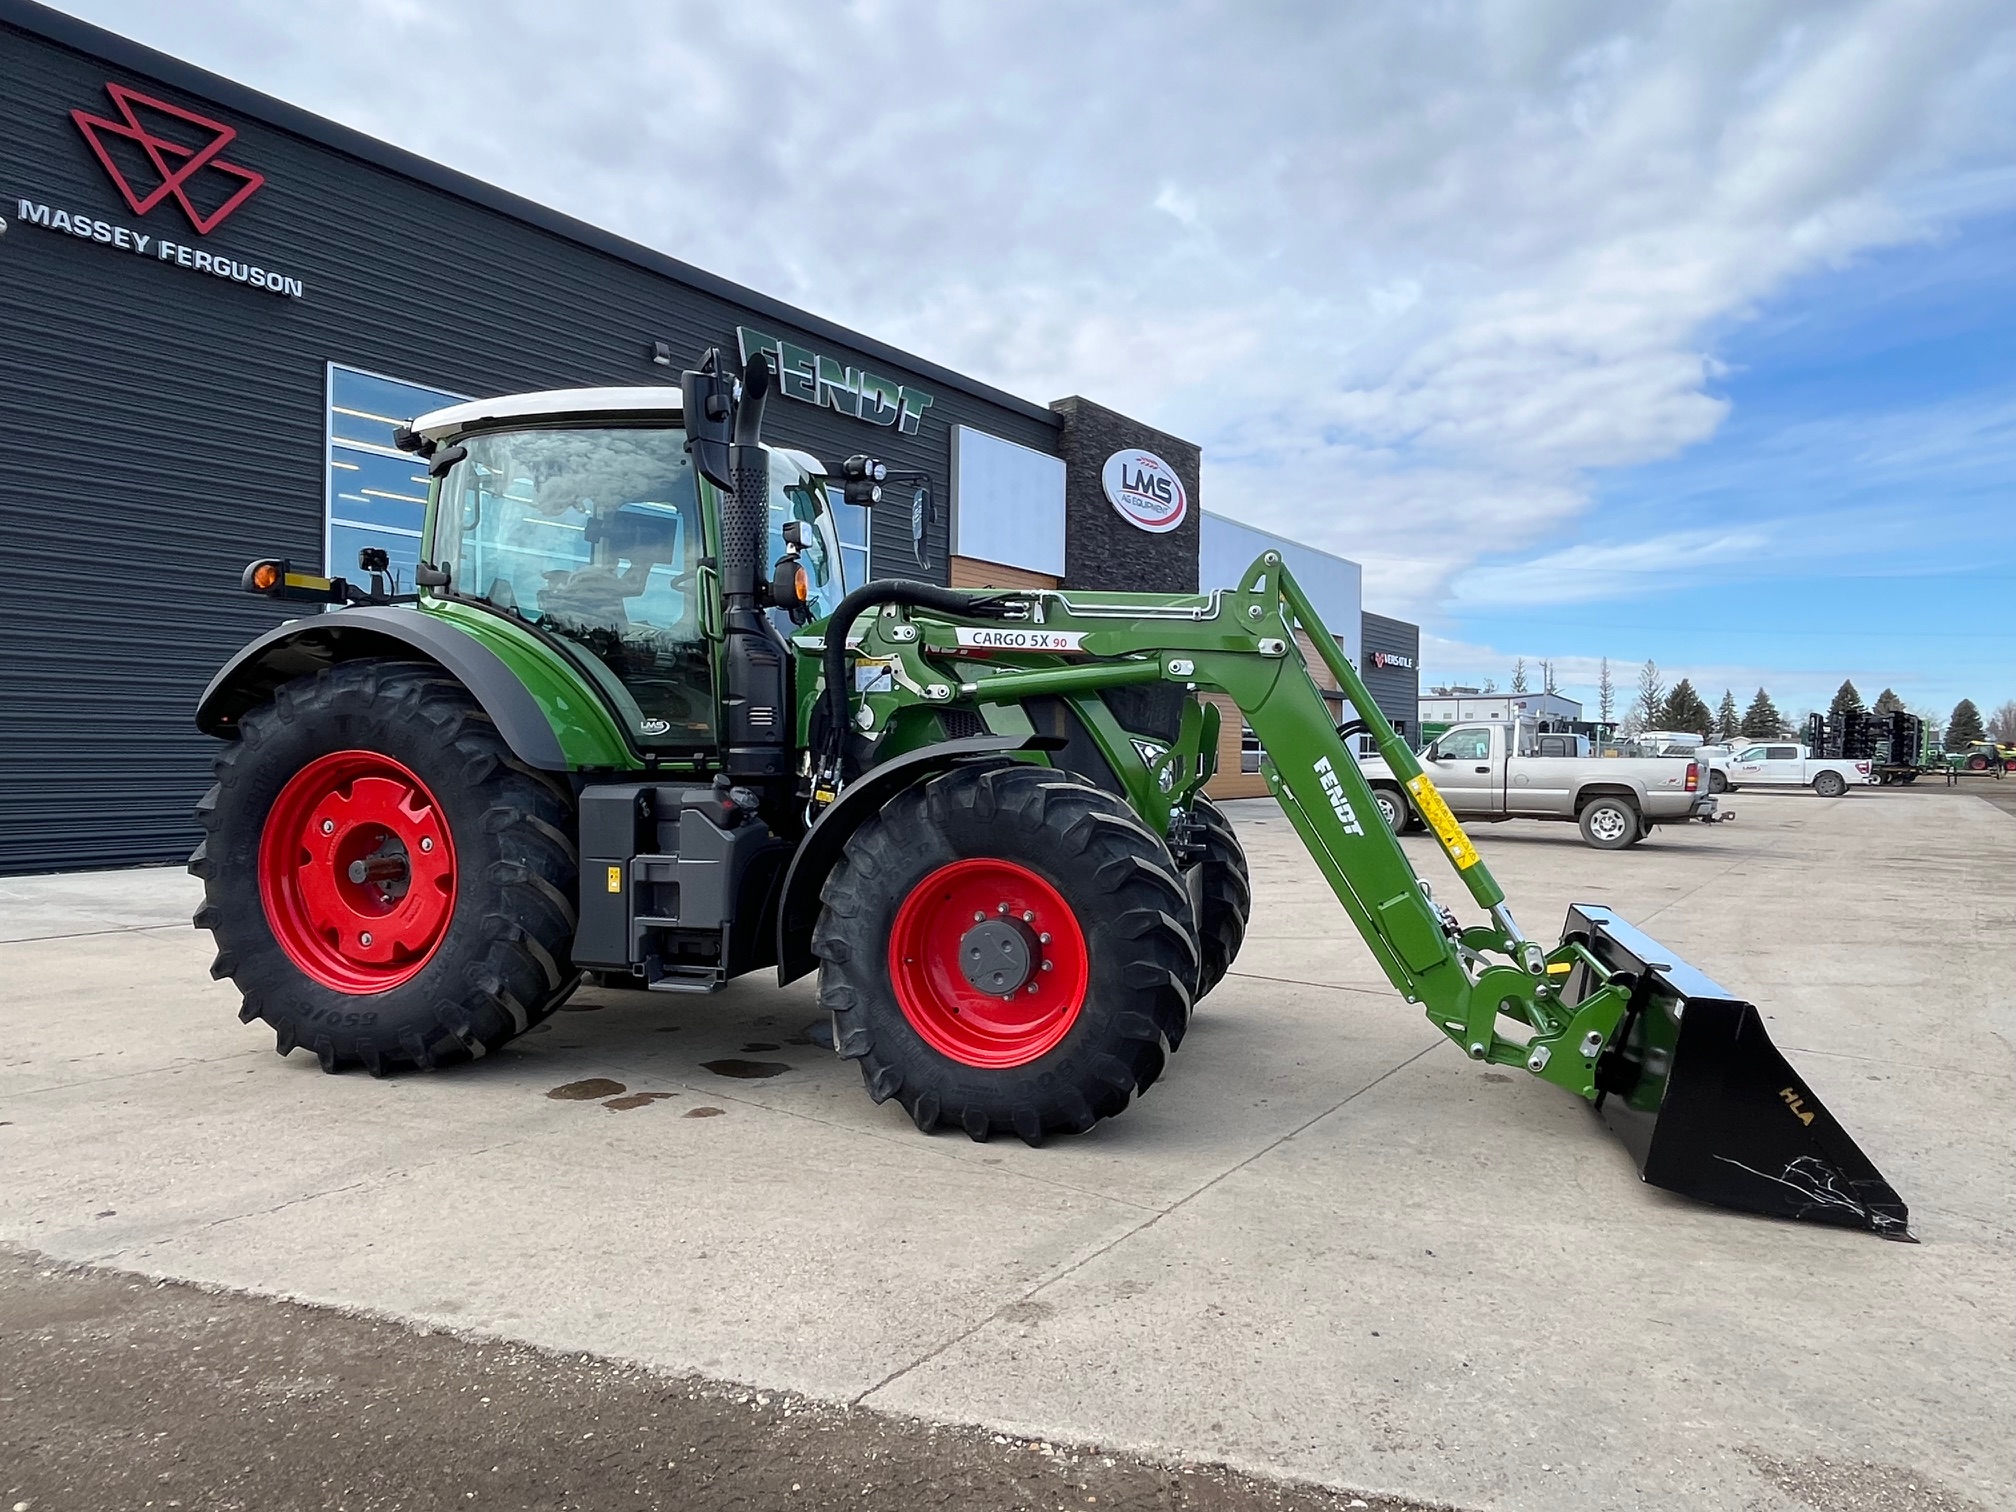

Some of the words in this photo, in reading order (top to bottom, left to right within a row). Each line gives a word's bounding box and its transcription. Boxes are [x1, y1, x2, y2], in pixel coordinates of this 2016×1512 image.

[17, 198, 150, 253] MASSEY
[157, 240, 303, 298] FERGUSON
[736, 325, 934, 436] FENDT
[1122, 463, 1172, 504] LMS
[1121, 493, 1132, 504] AG
[1132, 496, 1169, 516] EQUIPMENT
[972, 631, 1026, 646] CARGO
[1030, 634, 1050, 647] 5X
[1053, 638, 1067, 648] 90
[641, 721, 664, 729] LMS
[1312, 755, 1365, 837] FENDT
[1778, 1086, 1815, 1127] HLA
